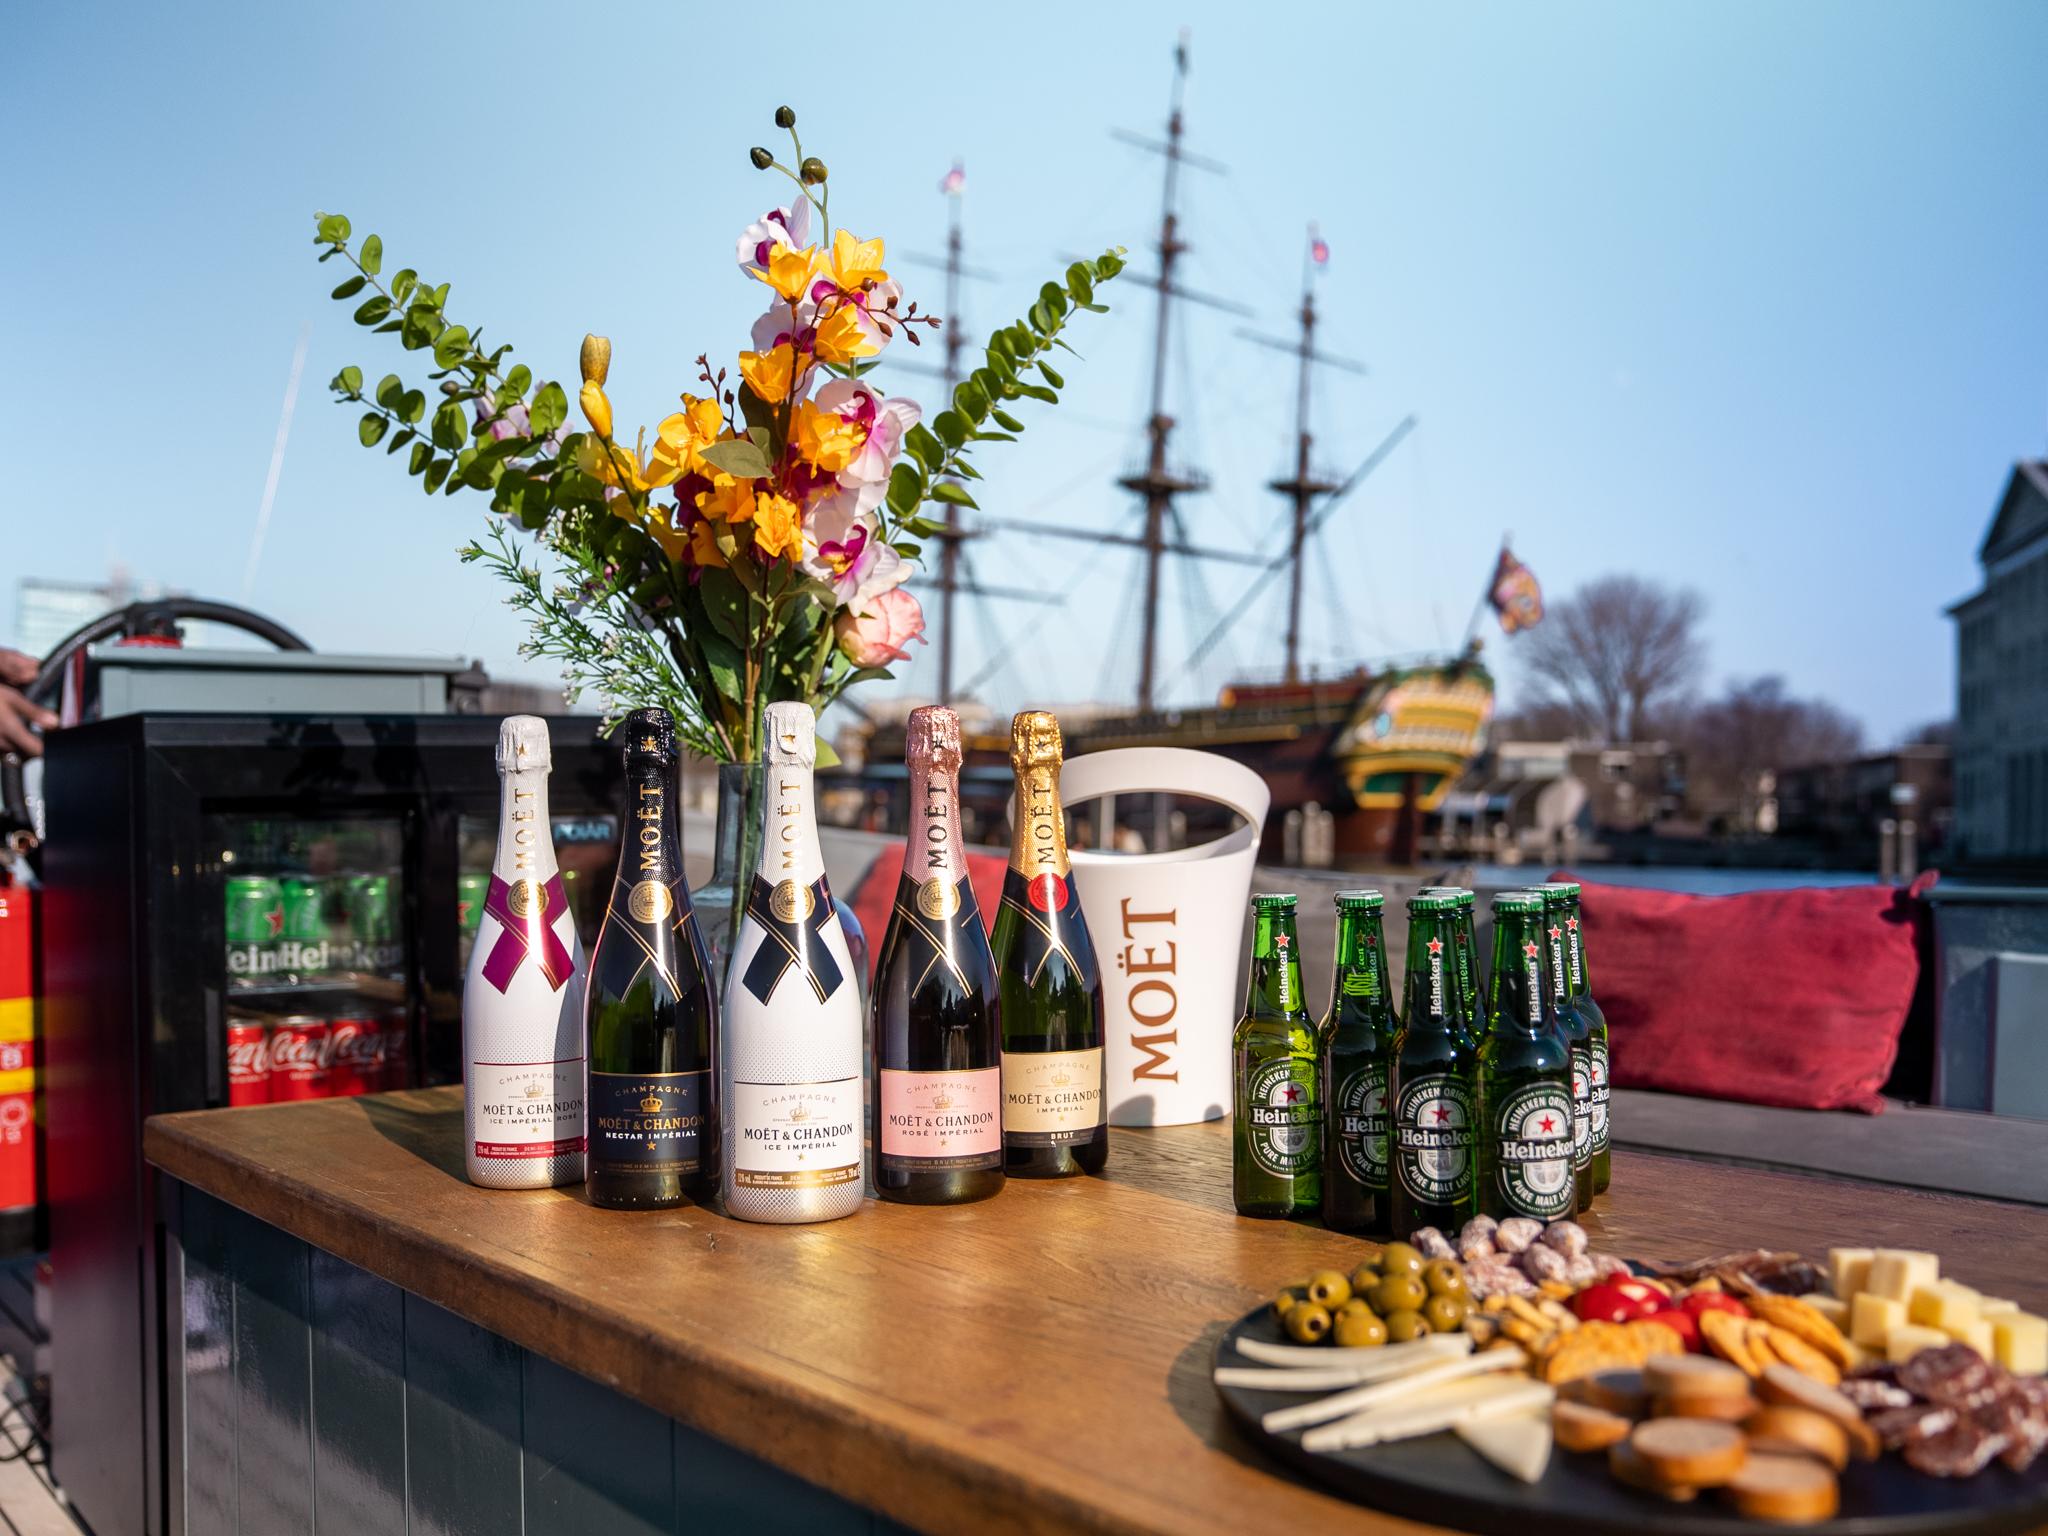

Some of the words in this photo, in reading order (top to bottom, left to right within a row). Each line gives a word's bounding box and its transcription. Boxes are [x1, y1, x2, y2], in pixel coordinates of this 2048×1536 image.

[511, 788, 536, 871] MOËT
[637, 783, 662, 870] MOËT
[778, 780, 802, 869] MOËT
[924, 782, 948, 869] MOËT
[1030, 784, 1056, 864] MOËT
[1552, 944, 1565, 997] Heineken
[1570, 934, 1581, 985] Heineken
[1278, 950, 1289, 1005] Heineken
[1368, 951, 1380, 1006] Heineken
[1429, 957, 1442, 1016] Heineken
[1116, 897, 1179, 1084] MOËT
[1528, 962, 1542, 1023] Heineken
[499, 1073, 568, 1085] CHAMPAGNE
[1026, 1062, 1090, 1074] CHAMPAGNE
[615, 1086, 689, 1097] CHAMPAGNE
[906, 1083, 977, 1094] CHAMPAGNE
[1008, 1093, 1042, 1105] MOËT
[1044, 1096, 1052, 1104] &
[1054, 1088, 1103, 1104] CHANDON
[1258, 1069, 1291, 1100] HEINEKEN
[1350, 1076, 1386, 1107] HEINEKEN
[483, 1104, 514, 1115] MOËT
[516, 1107, 524, 1115] &
[527, 1099, 583, 1115] CHANDON
[762, 1094, 837, 1106] CHAMPAGNE
[1406, 1087, 1441, 1120] HEINEKEN
[507, 1116, 553, 1125] IMPÉRIAL
[556, 1112, 578, 1122] ROSÉ
[598, 1116, 631, 1130] MOËT
[633, 1121, 641, 1130] &
[643, 1114, 705, 1131] CHANDON
[889, 1114, 922, 1127] MOËT
[924, 1118, 933, 1127] &
[935, 1112, 994, 1127] CHANDON
[1253, 1108, 1317, 1125] Heineke
[1345, 1116, 1386, 1133] Hein
[1508, 1096, 1547, 1132] HEINEKEN
[605, 1132, 643, 1140] NECTAR
[648, 1130, 697, 1140] IMPÉRIAL
[744, 1128, 780, 1141] MOËT
[782, 1131, 791, 1141] &
[793, 1123, 854, 1141] CHANDON
[902, 1129, 929, 1137] ROSÉ
[934, 1127, 984, 1137] IMPÉRIAL
[1050, 1131, 1075, 1140] BRUT
[1401, 1128, 1472, 1147] Heineke
[787, 1141, 838, 1150] IMPÉRIAL
[1260, 1142, 1280, 1162] PURE
[1280, 1155, 1301, 1167] MALT
[1502, 1139, 1575, 1160] Heineken
[1353, 1151, 1374, 1173] PURE
[1374, 1166, 1388, 1176] MA
[1408, 1165, 1429, 1188] PURE
[1429, 1181, 1454, 1193] MALT
[1512, 1179, 1535, 1203] PURE
[1535, 1194, 1559, 1207] MALT
